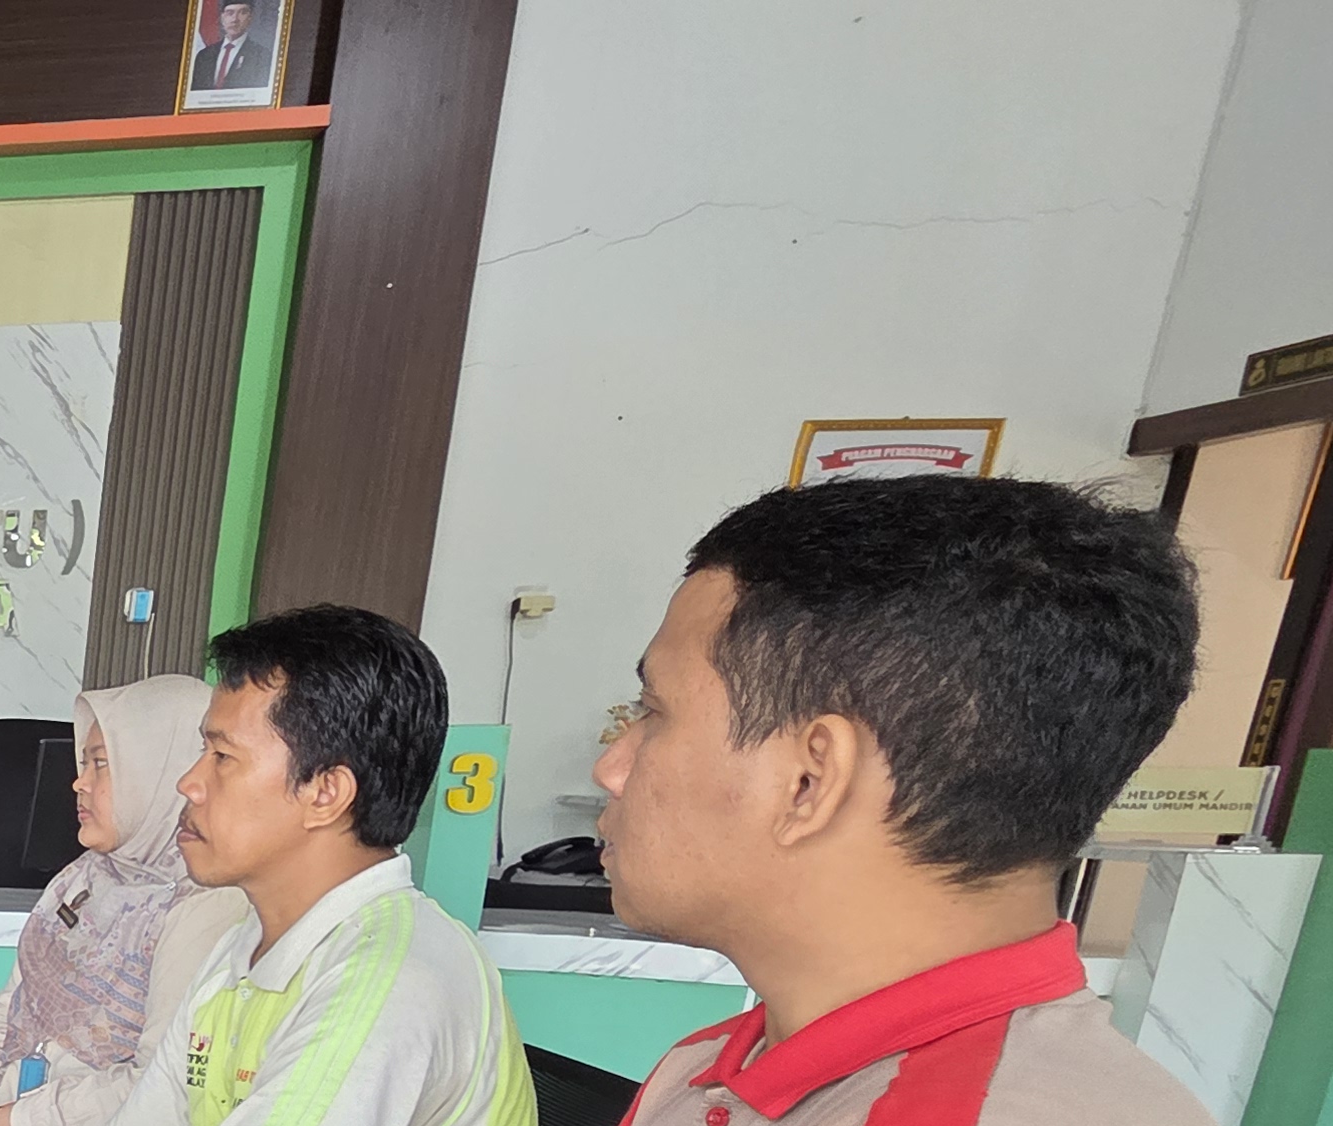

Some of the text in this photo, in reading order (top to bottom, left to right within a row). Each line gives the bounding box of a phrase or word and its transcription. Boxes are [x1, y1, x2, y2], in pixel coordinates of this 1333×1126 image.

[446, 753, 498, 814] 3
[1127, 790, 1209, 801] HELPDESK
[1153, 802, 1193, 811] UMUM
